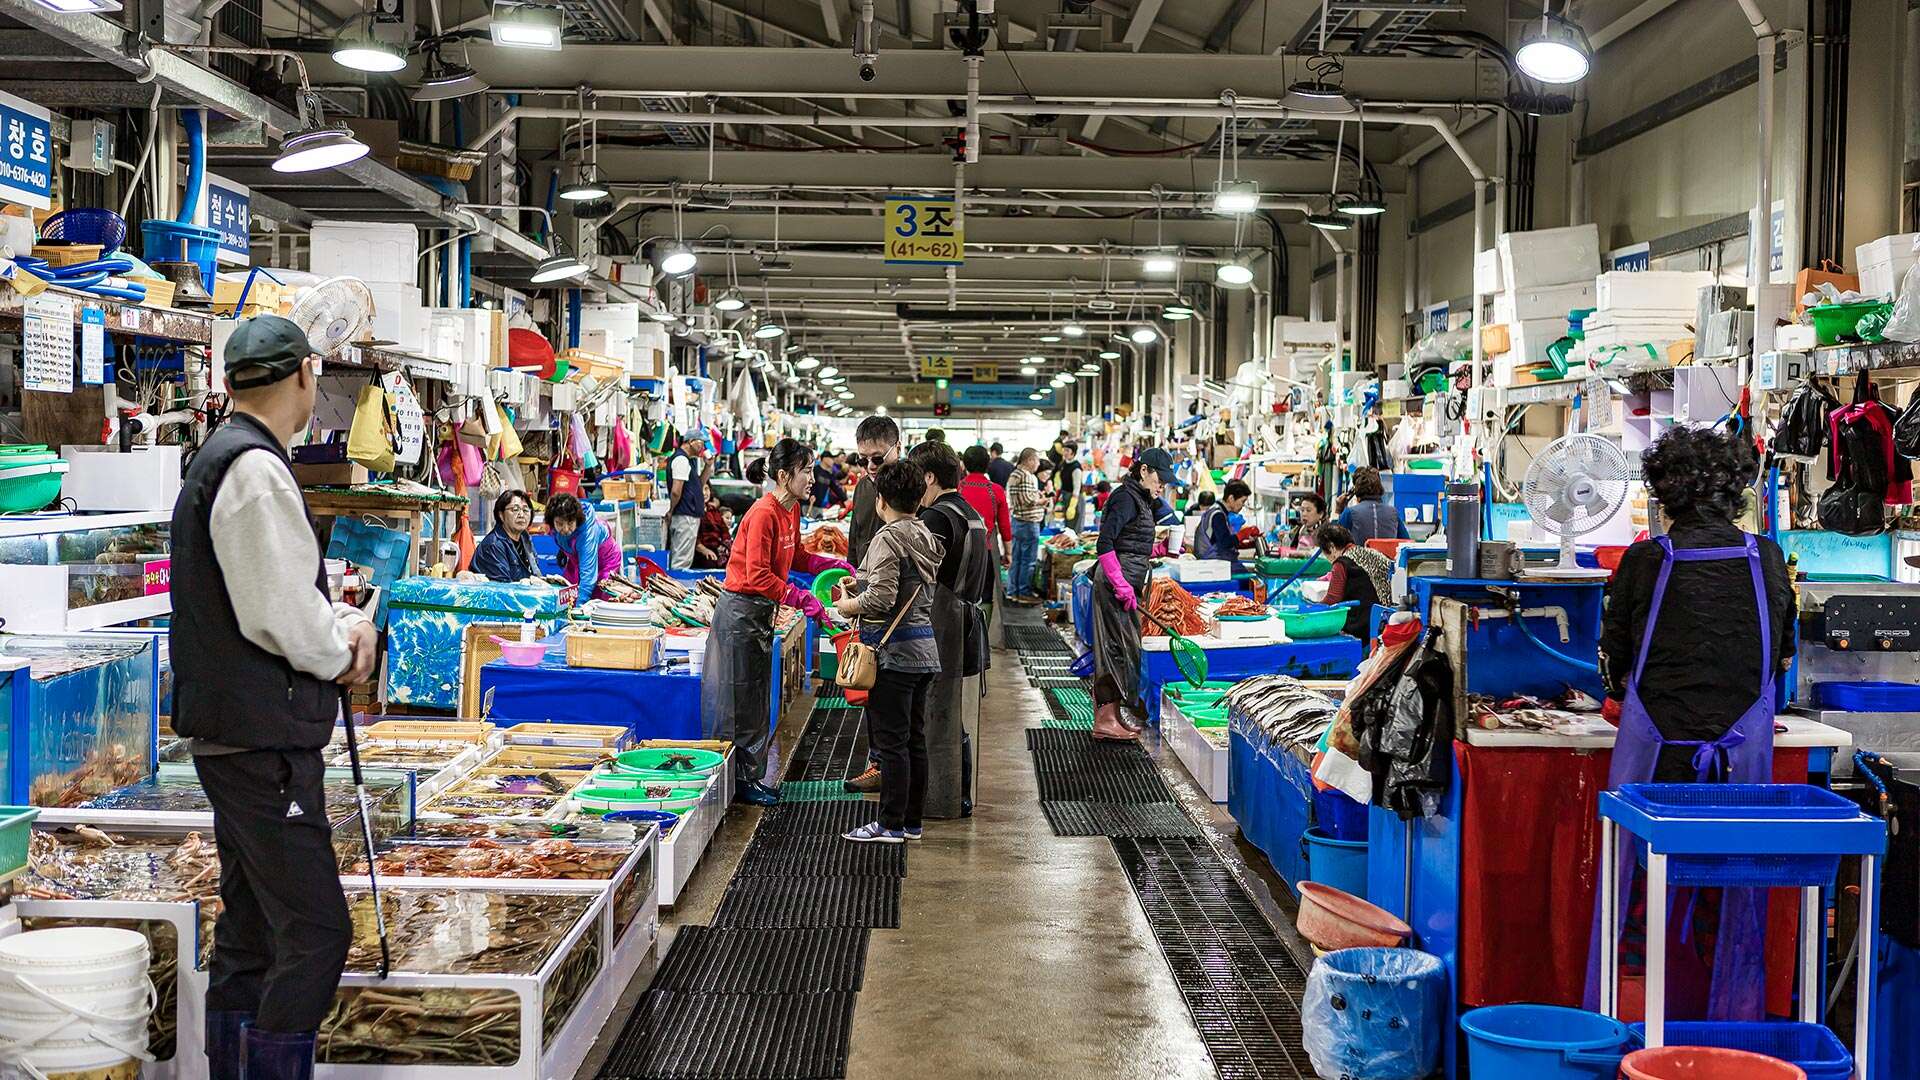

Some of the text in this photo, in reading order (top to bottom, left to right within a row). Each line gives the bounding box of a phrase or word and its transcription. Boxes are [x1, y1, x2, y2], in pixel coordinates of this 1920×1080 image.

[0, 114, 47, 163] 창호
[211, 193, 247, 234] 철수네
[895, 204, 954, 237] 3조
[891, 240, 958, 259] (41~62)
